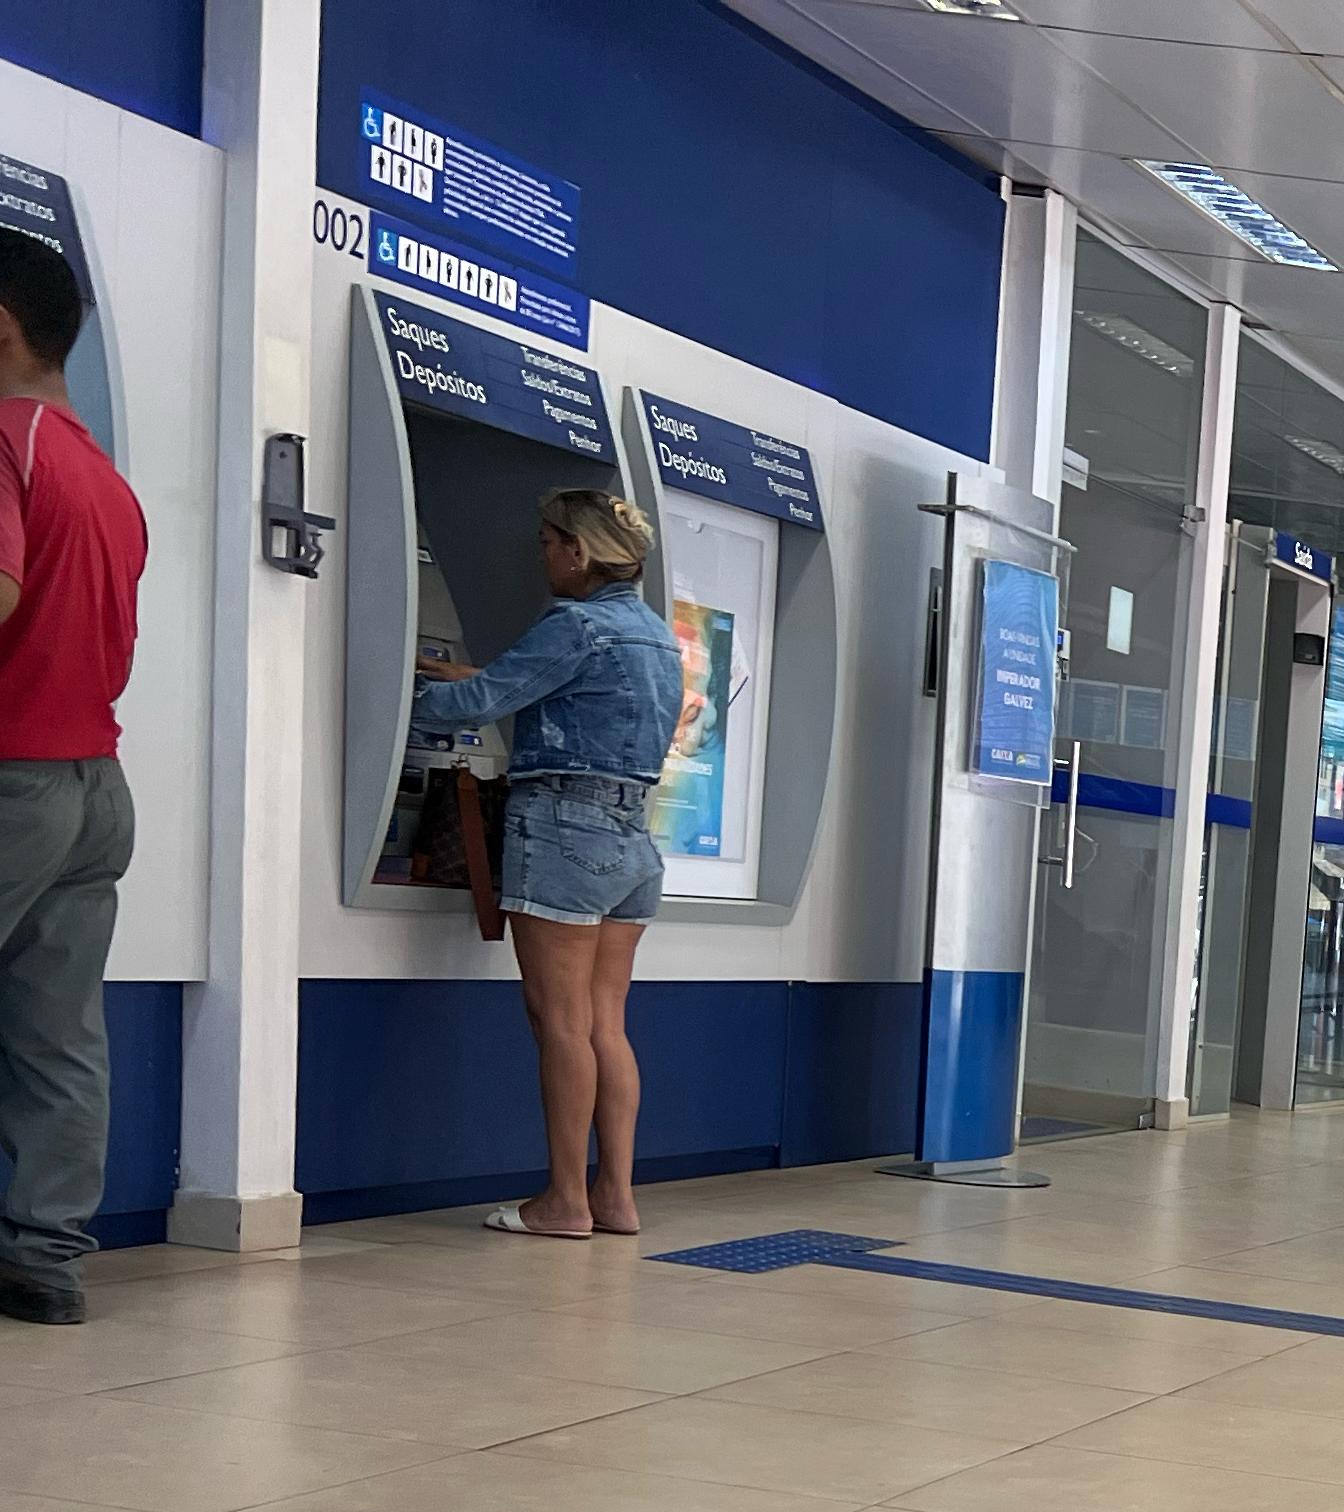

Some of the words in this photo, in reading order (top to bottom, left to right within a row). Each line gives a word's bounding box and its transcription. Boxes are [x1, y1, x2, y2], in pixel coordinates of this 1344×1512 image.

[312, 199, 365, 260] 002
[386, 307, 450, 353] Saques
[396, 350, 487, 405] Depósitos
[650, 405, 698, 442] Saques
[658, 442, 727, 485] Depósitos
[1003, 692, 1034, 710] GALVEZ
